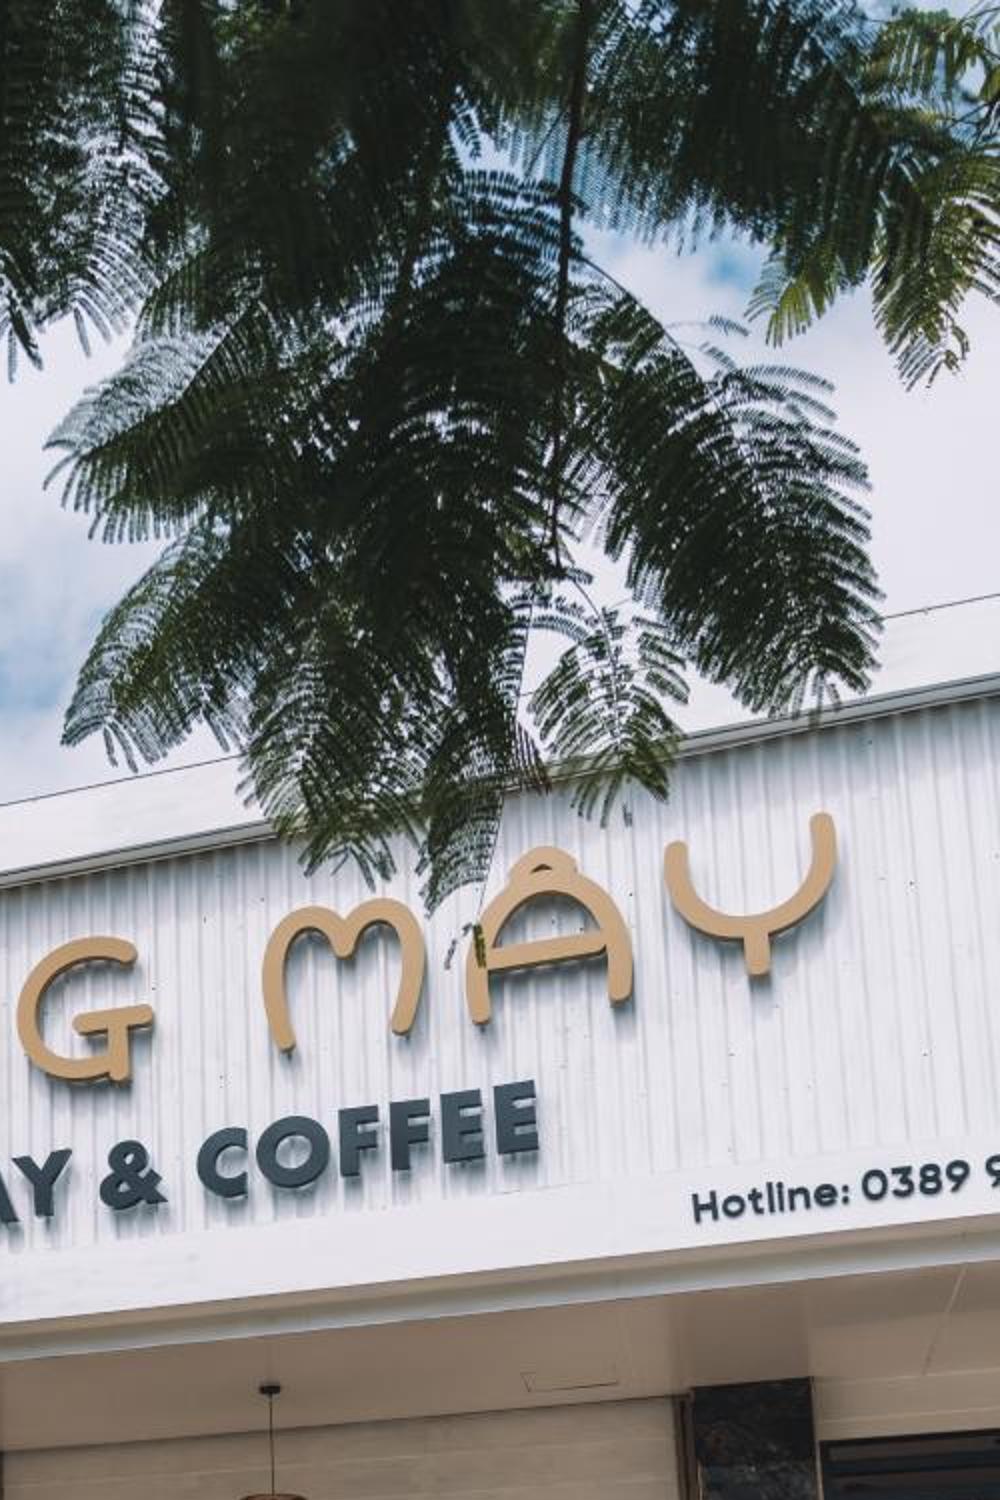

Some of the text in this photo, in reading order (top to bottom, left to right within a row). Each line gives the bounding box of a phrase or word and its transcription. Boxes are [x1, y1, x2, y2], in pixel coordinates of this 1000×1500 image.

[261, 811, 837, 1053] MÂY
[98, 1139, 168, 1211] &
[196, 1079, 541, 1199] COFFEE
[690, 1181, 850, 1225] Hotline:
[860, 1158, 970, 1203] 0389
